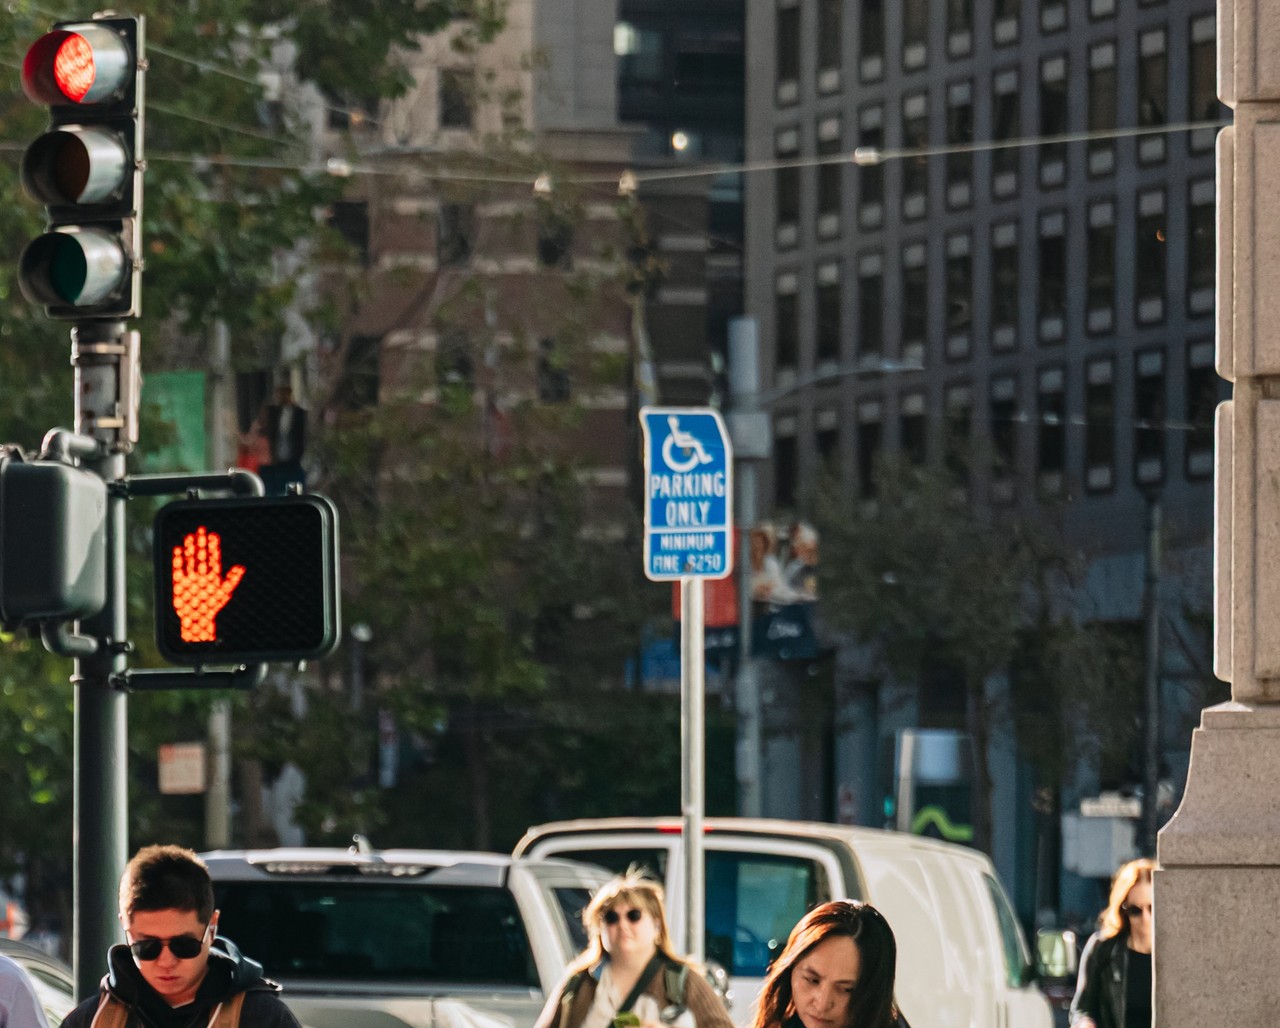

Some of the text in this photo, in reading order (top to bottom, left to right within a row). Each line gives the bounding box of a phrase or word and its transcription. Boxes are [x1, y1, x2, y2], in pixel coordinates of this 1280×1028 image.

[651, 471, 726, 498] PARKING
[666, 501, 710, 527] ONLY
[660, 533, 715, 551] MINIMUM
[653, 554, 722, 572] FINE $250
